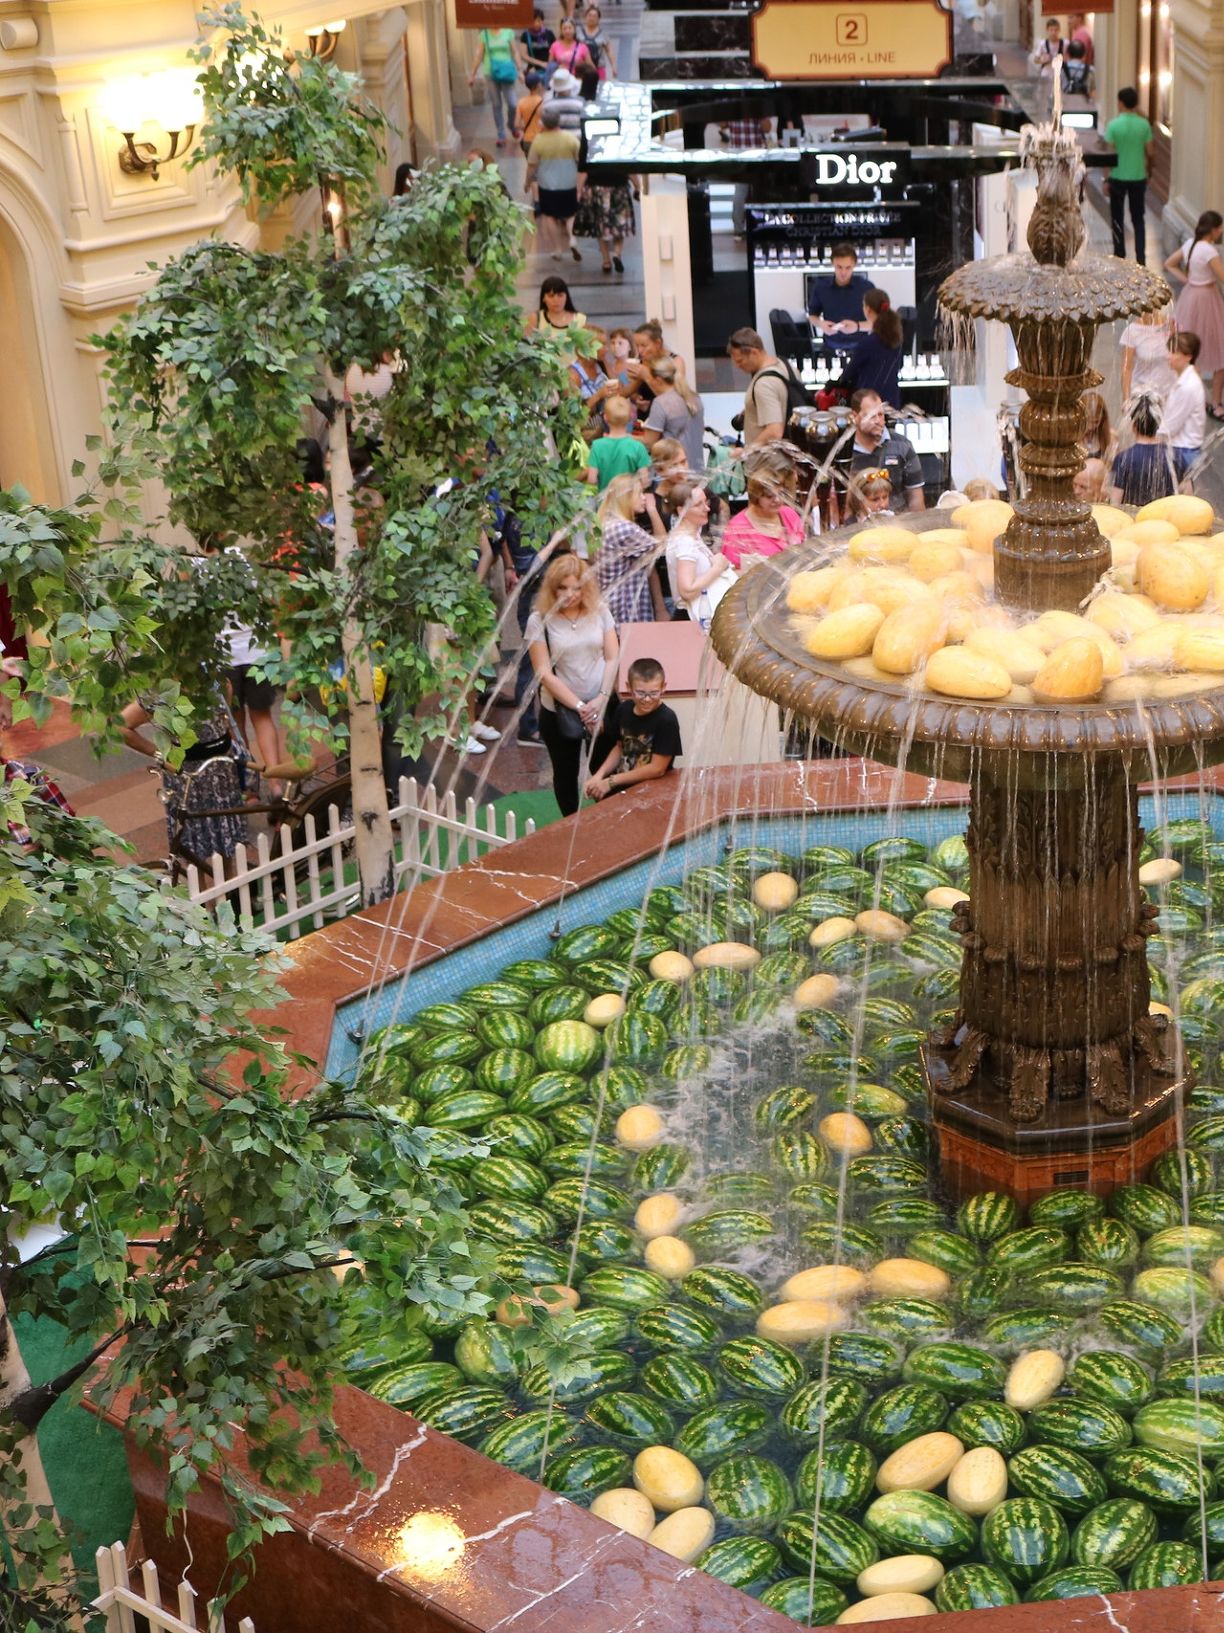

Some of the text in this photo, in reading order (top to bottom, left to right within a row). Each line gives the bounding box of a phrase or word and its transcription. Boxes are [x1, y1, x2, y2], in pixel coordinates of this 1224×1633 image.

[845, 20, 858, 40] 2
[809, 51, 896, 64] ЛИНИЯ LINE
[815, 154, 897, 184] Dior
